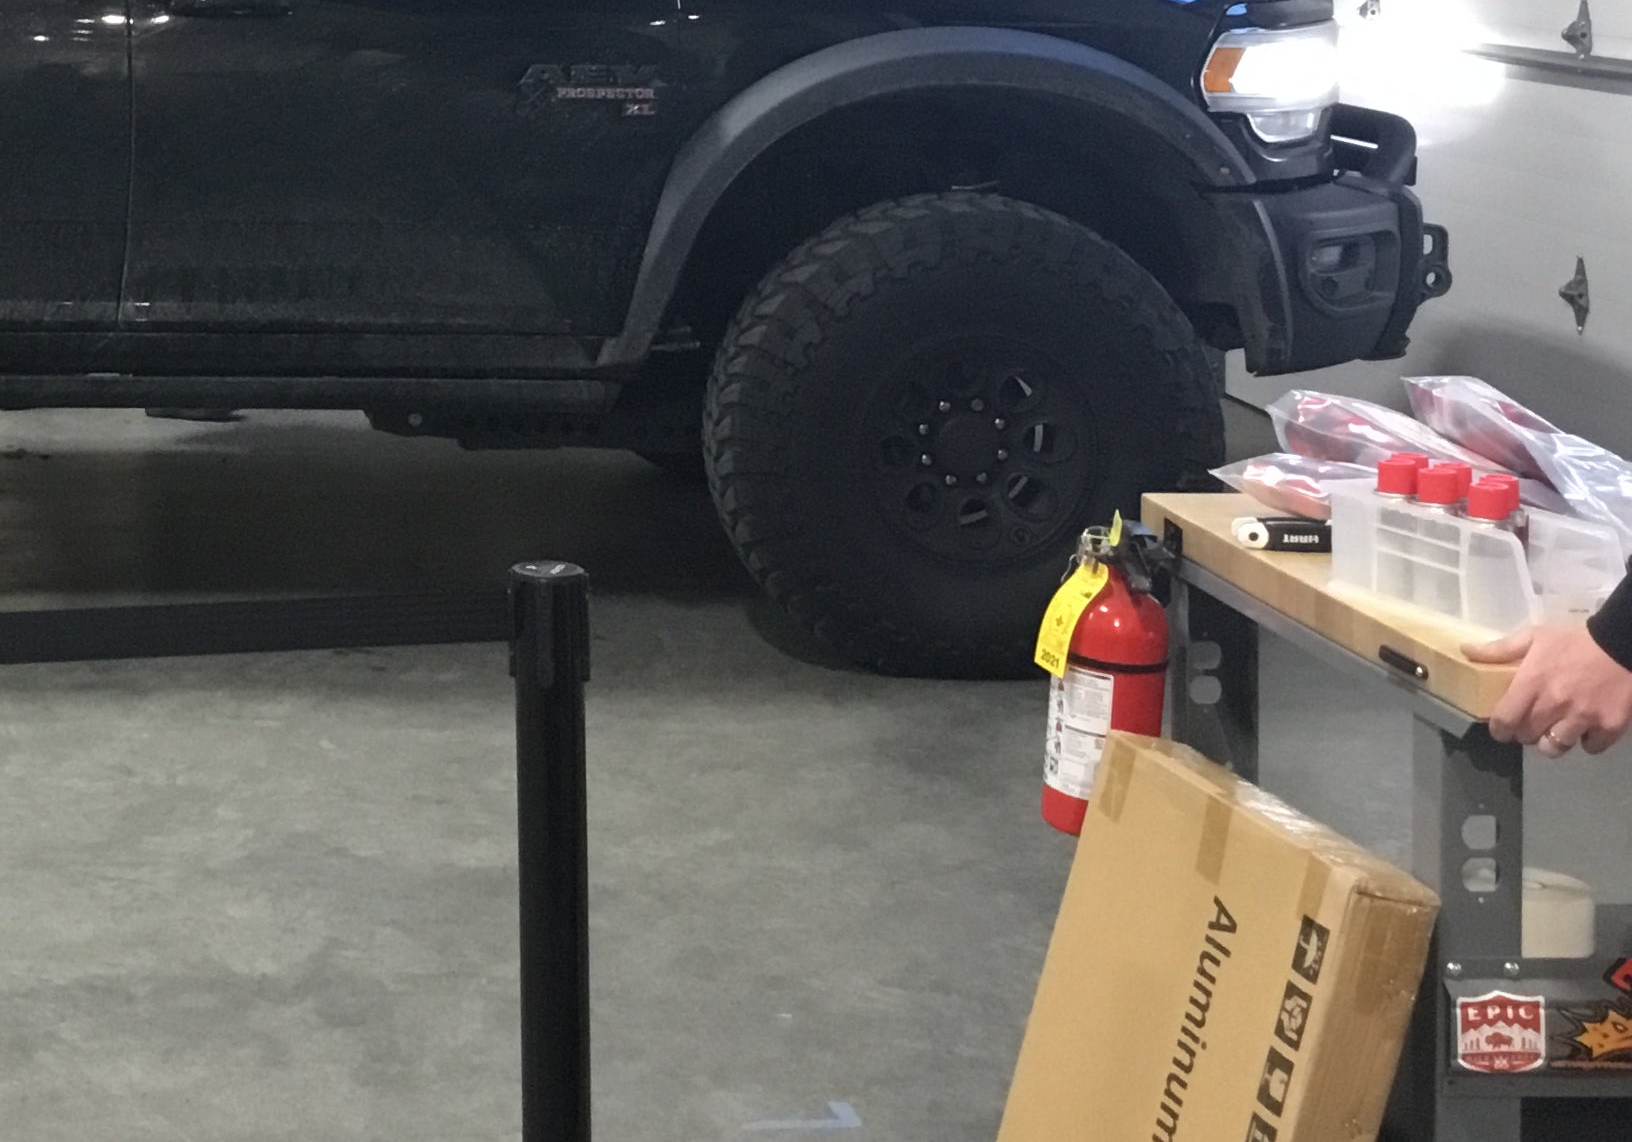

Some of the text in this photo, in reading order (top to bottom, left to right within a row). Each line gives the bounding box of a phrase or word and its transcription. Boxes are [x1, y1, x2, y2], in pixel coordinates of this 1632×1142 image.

[556, 87, 655, 99] PROSPECTOR
[1040, 649, 1061, 669] 2021
[1467, 1004, 1535, 1022] EPIC
